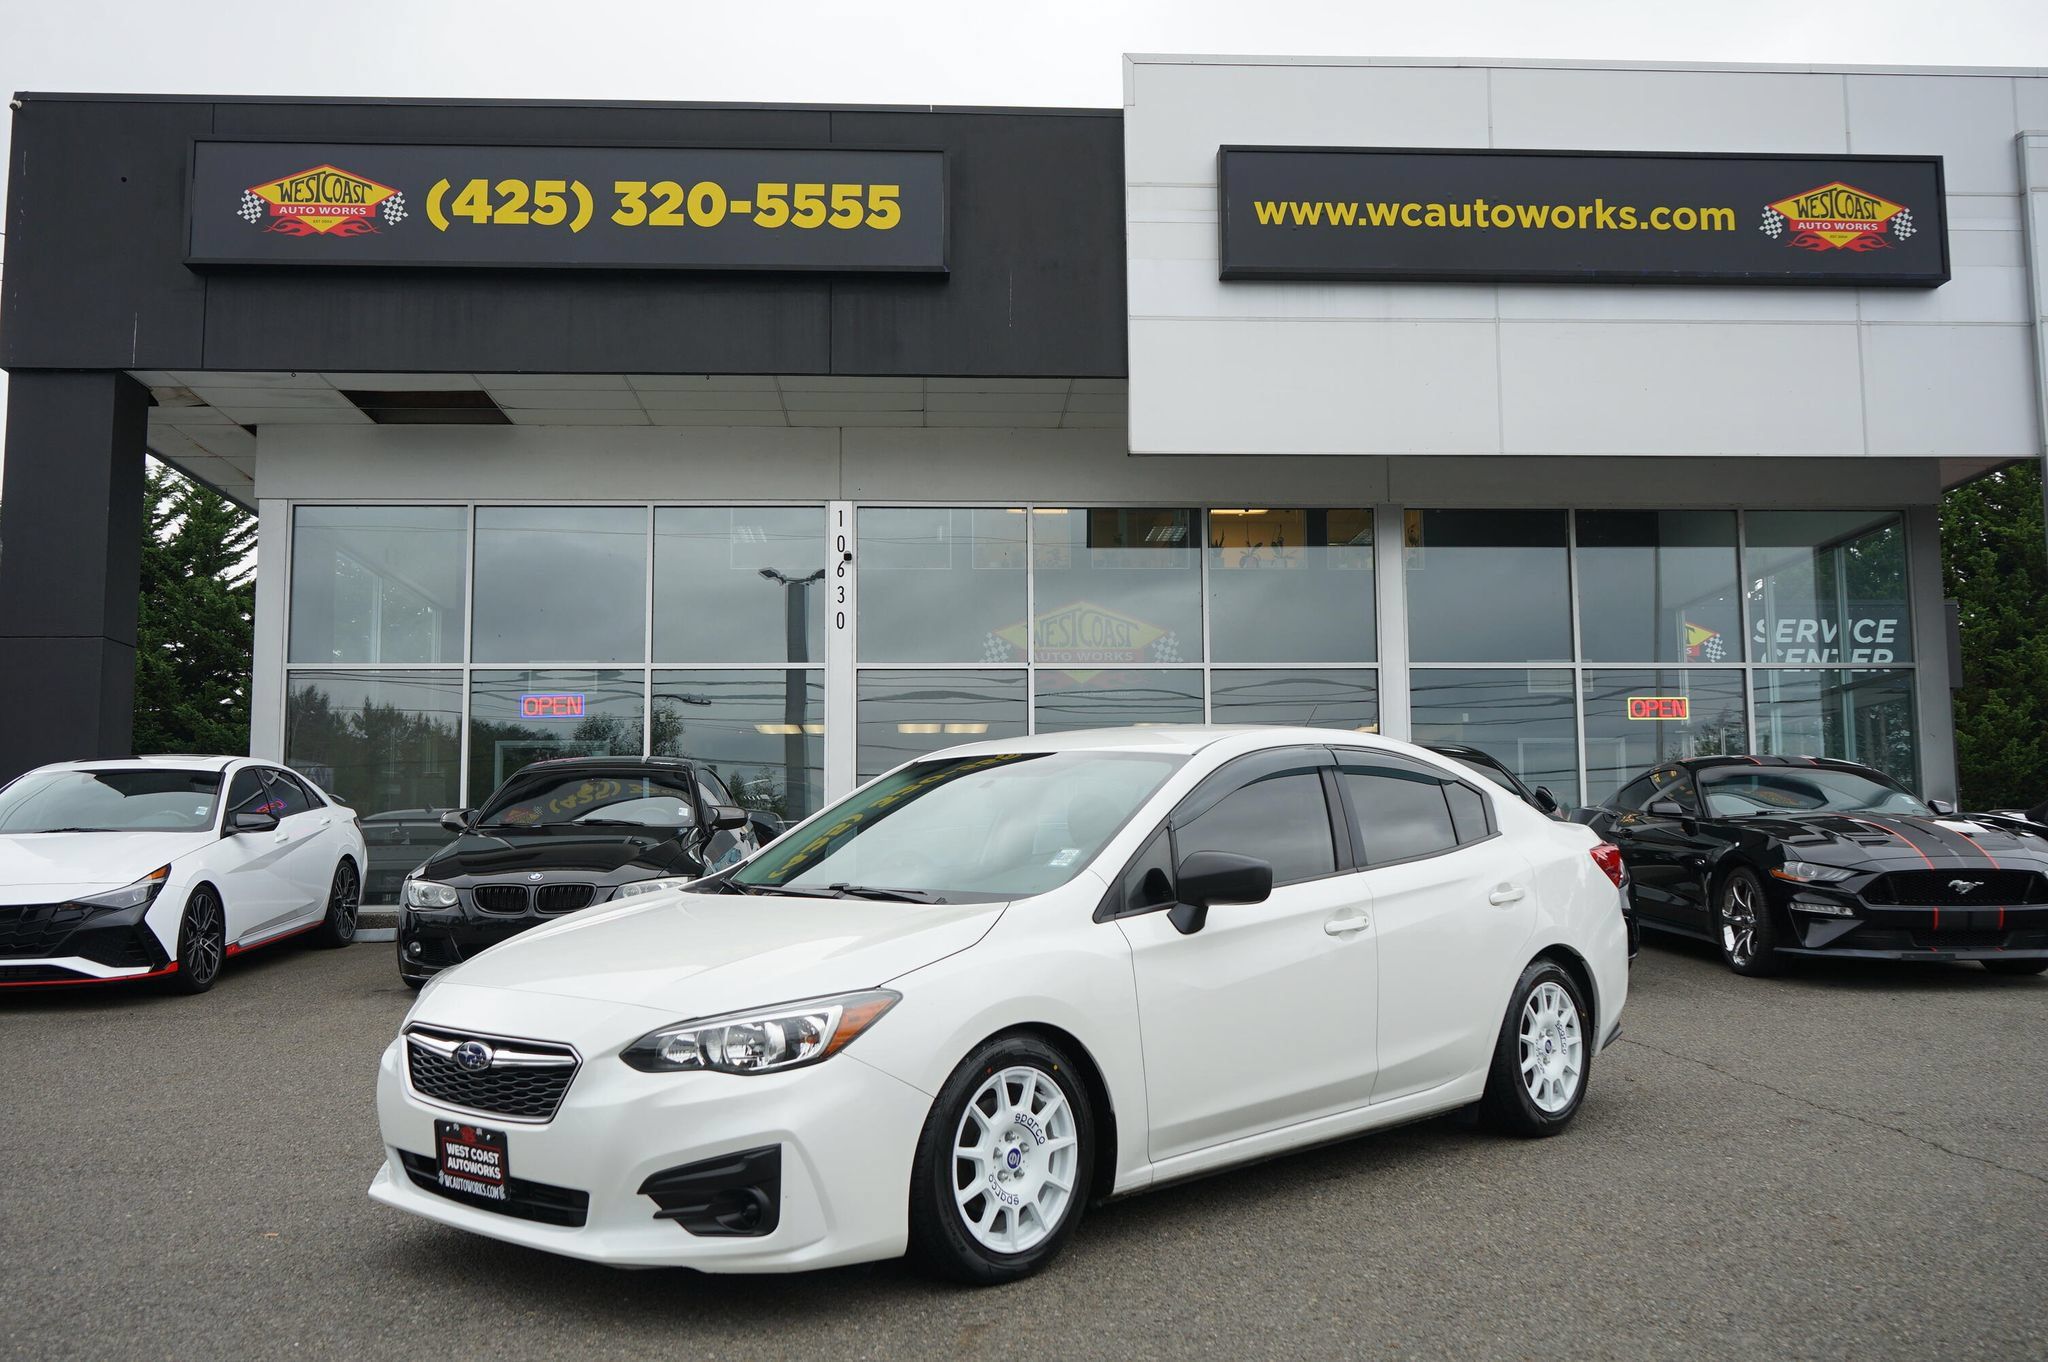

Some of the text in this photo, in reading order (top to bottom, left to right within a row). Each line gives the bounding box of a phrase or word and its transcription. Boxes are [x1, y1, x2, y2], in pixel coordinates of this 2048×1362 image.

[279, 206, 367, 215] AUTO WORKS
[426, 179, 901, 232] (425) 320-5555
[1254, 198, 1735, 231] www.wcautoworks.com
[1798, 222, 1878, 231] AUTO WORKS
[1077, 651, 1134, 662] WORKS
[524, 697, 582, 715] OPEN
[1630, 700, 1686, 717] OPEN
[1014, 1113, 1046, 1145] sparco
[446, 1143, 499, 1165] WEST COAST
[447, 1157, 501, 1179] AUTOWORKS
[988, 1174, 1020, 1205] sparco
